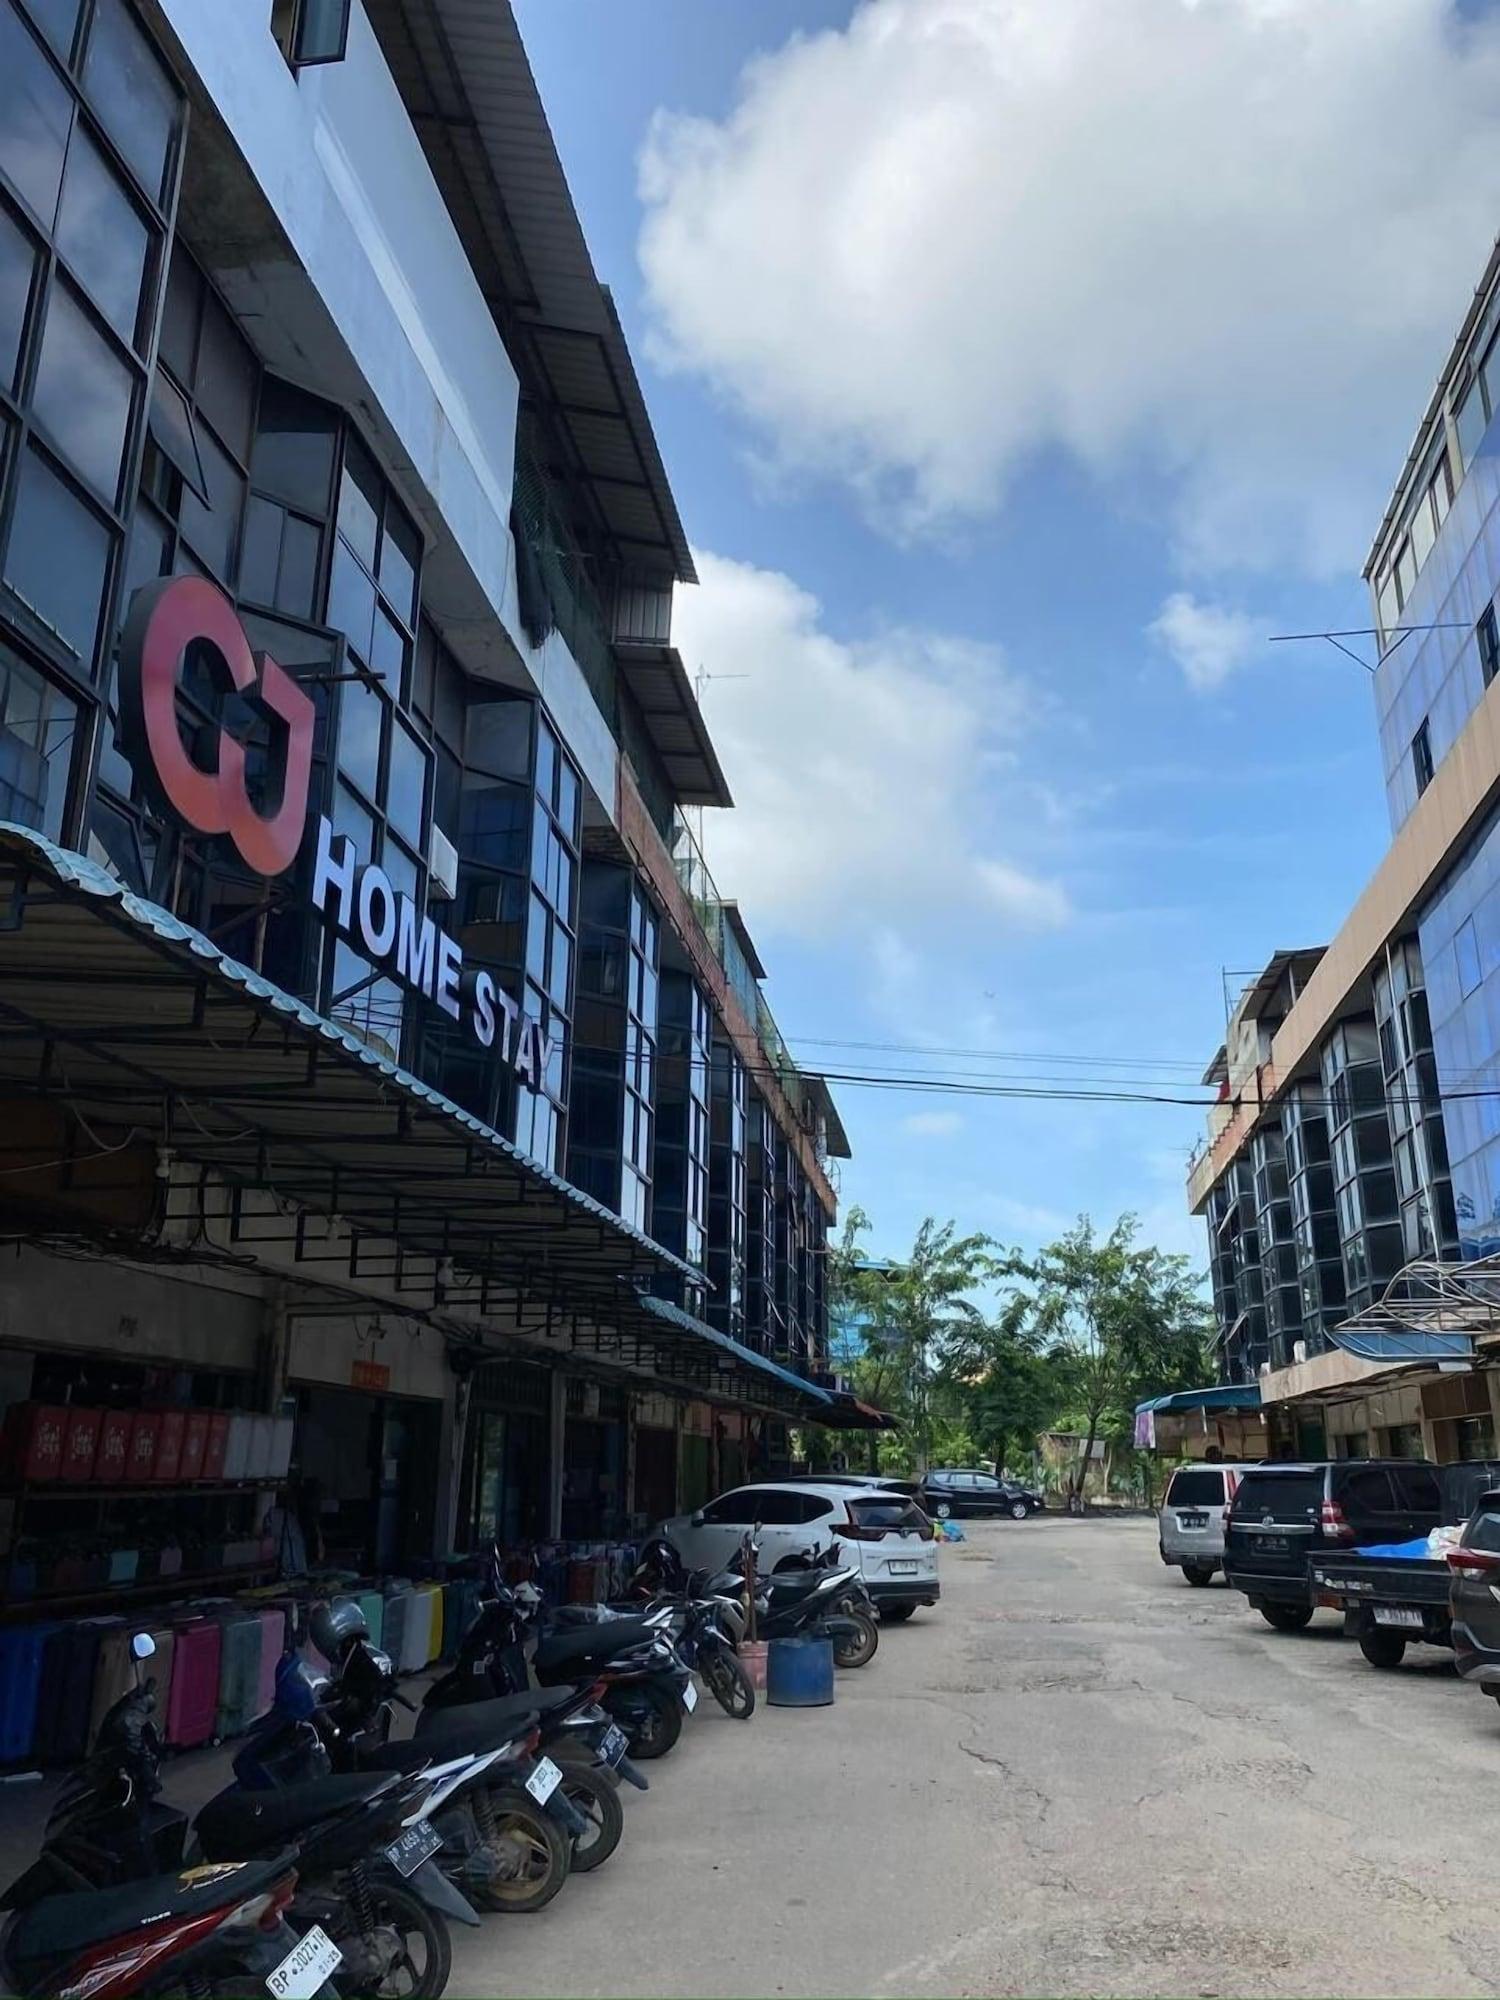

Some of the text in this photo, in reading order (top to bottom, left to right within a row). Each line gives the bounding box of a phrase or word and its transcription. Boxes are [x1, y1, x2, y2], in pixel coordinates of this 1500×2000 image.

[312, 814, 554, 1092] HOME STAY
[271, 1969, 291, 1994] BP
[291, 1941, 317, 1972] 3027
